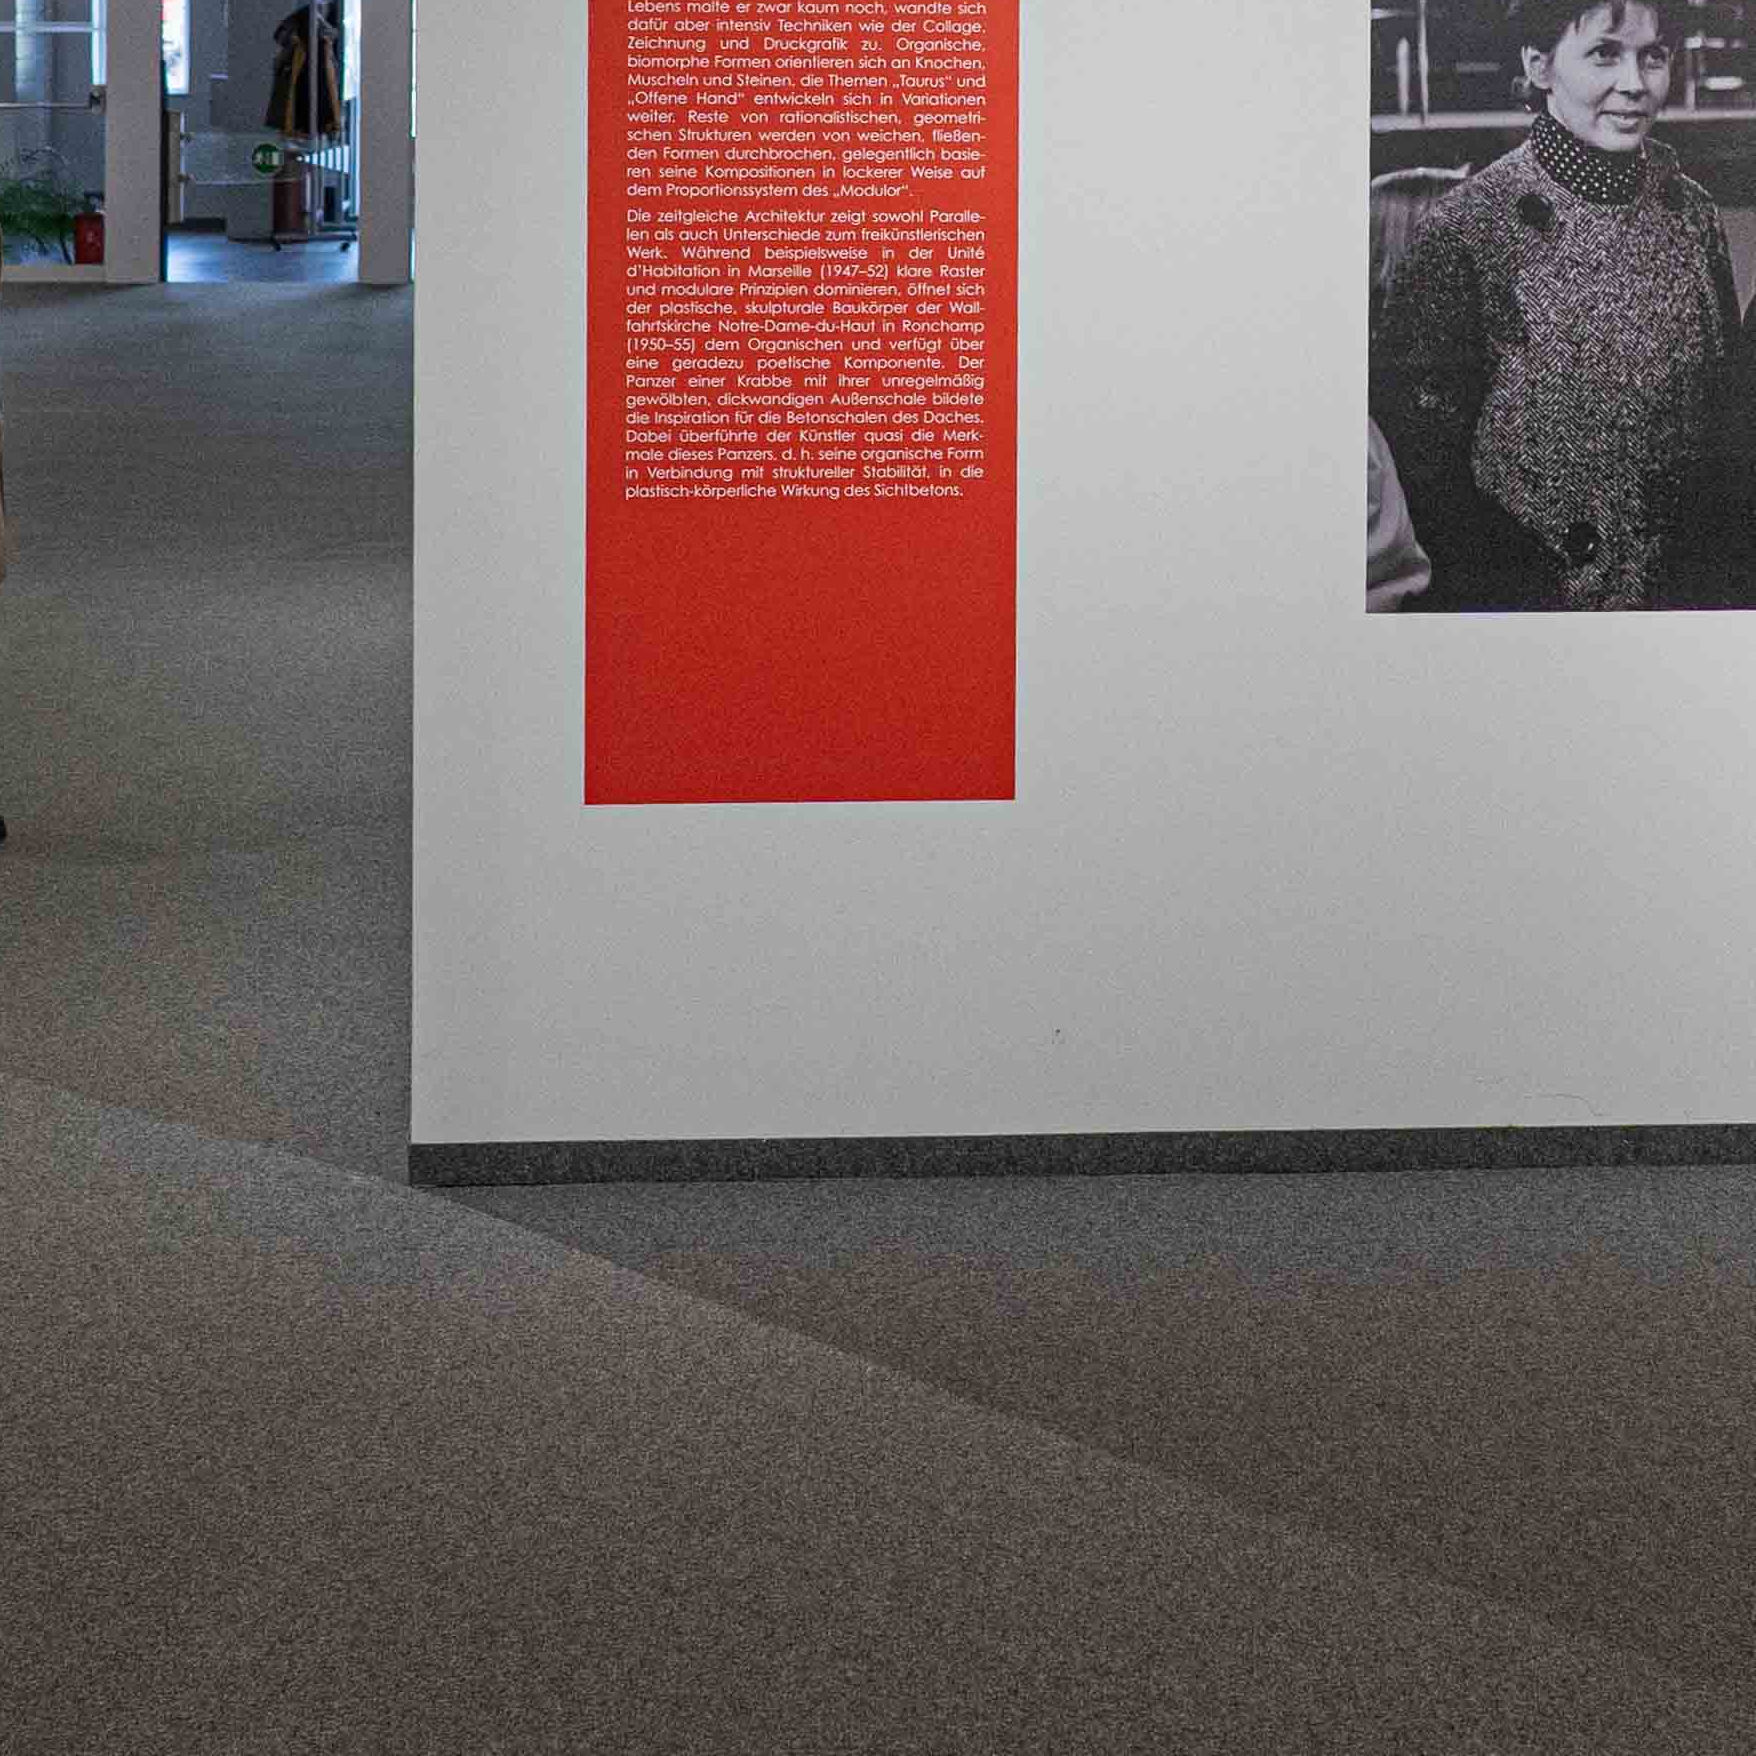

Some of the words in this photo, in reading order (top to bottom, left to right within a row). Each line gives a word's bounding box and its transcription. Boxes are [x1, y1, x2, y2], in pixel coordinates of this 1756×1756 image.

[627, 19, 669, 32] dafür
[673, 19, 711, 32] aber
[715, 19, 772, 32] intensiv
[777, 19, 853, 33] Techniken
[857, 20, 885, 33] wie
[890, 20, 917, 33] der
[922, 20, 986, 36] Collage,
[627, 37, 707, 53] Zeichnung
[719, 37, 750, 50] und
[763, 37, 849, 53] Druckgrafik
[861, 40, 883, 51] zu.
[627, 55, 710, 71] biomorphe
[714, 56, 771, 69] Formen
[774, 56, 855, 69] orientieren
[858, 56, 887, 69] sich
[890, 59, 911, 69] an
[915, 56, 986, 71] Knochen,
[626, 147, 658, 160] den
[662, 147, 720, 160] Formen
[841, 148, 936, 163] gelegentlich
[940, 148, 986, 161] basie-
[626, 168, 652, 178] ren
[658, 165, 698, 179] seine
[704, 166, 816, 181] Kompositionen
[822, 166, 836, 179] in
[842, 166, 904, 179] lockerer
[910, 166, 954, 179] Weise
[960, 166, 986, 179] auf
[626, 210, 652, 223] Die
[656, 210, 740, 226] zeitgleiche
[743, 210, 827, 223] Architektur
[829, 210, 868, 226] zeigt
[871, 210, 924, 223] sowohl
[929, 210, 987, 223] Paralle-
[625, 228, 650, 241] len
[653, 228, 675, 241] als
[678, 228, 719, 241] auch
[723, 228, 821, 241] Unterschiede
[824, 231, 857, 241] zum
[860, 228, 986, 242] freikünstlerischen
[625, 247, 668, 260] Werk.
[680, 247, 751, 260] Während
[764, 247, 869, 262] beispielsweise
[881, 247, 895, 260] in
[908, 247, 935, 260] der
[947, 247, 986, 260] Unité
[625, 283, 657, 296] und
[660, 283, 735, 296] modulare
[739, 283, 809, 299] Prinzipien
[906, 283, 952, 296] öffnet
[955, 283, 986, 296] sich
[625, 301, 653, 314] der
[744, 301, 826, 317] skulpturale
[832, 301, 909, 317] Baukörper
[915, 301, 943, 314] der
[948, 301, 986, 314] Wall-
[625, 320, 712, 333] fahrtskirche
[882, 320, 896, 333] in
[902, 320, 985, 335] Ronchamp
[625, 356, 660, 369] eine
[671, 356, 745, 372] geradezu
[756, 356, 832, 372] poetische
[958, 356, 986, 369] Der
[625, 375, 677, 388] Panzer
[687, 375, 727, 388] einer
[737, 375, 793, 388] Krabbe
[803, 374, 828, 388] mit
[838, 374, 871, 387] ihrer
[881, 374, 985, 390] unregelmäßig
[625, 393, 711, 408] gewölbten,
[716, 393, 825, 408] dickwandigen
[830, 393, 927, 406] Außenschale
[932, 393, 985, 406] bildete
[625, 411, 651, 424] die
[654, 411, 731, 427] Inspiration
[734, 411, 755, 424] für
[757, 411, 782, 424] die
[786, 411, 888, 424] Betonschalen
[891, 411, 920, 424] des
[923, 411, 985, 424] Daches.
[625, 429, 672, 443] Dabei
[678, 429, 759, 442] überführte
[765, 429, 793, 442] der
[799, 429, 857, 442] Künstler
[863, 429, 904, 445] quasi
[910, 429, 935, 442] die
[942, 429, 984, 442] Merk-
[780, 484, 841, 500] Wirkung
[843, 484, 871, 497] des
